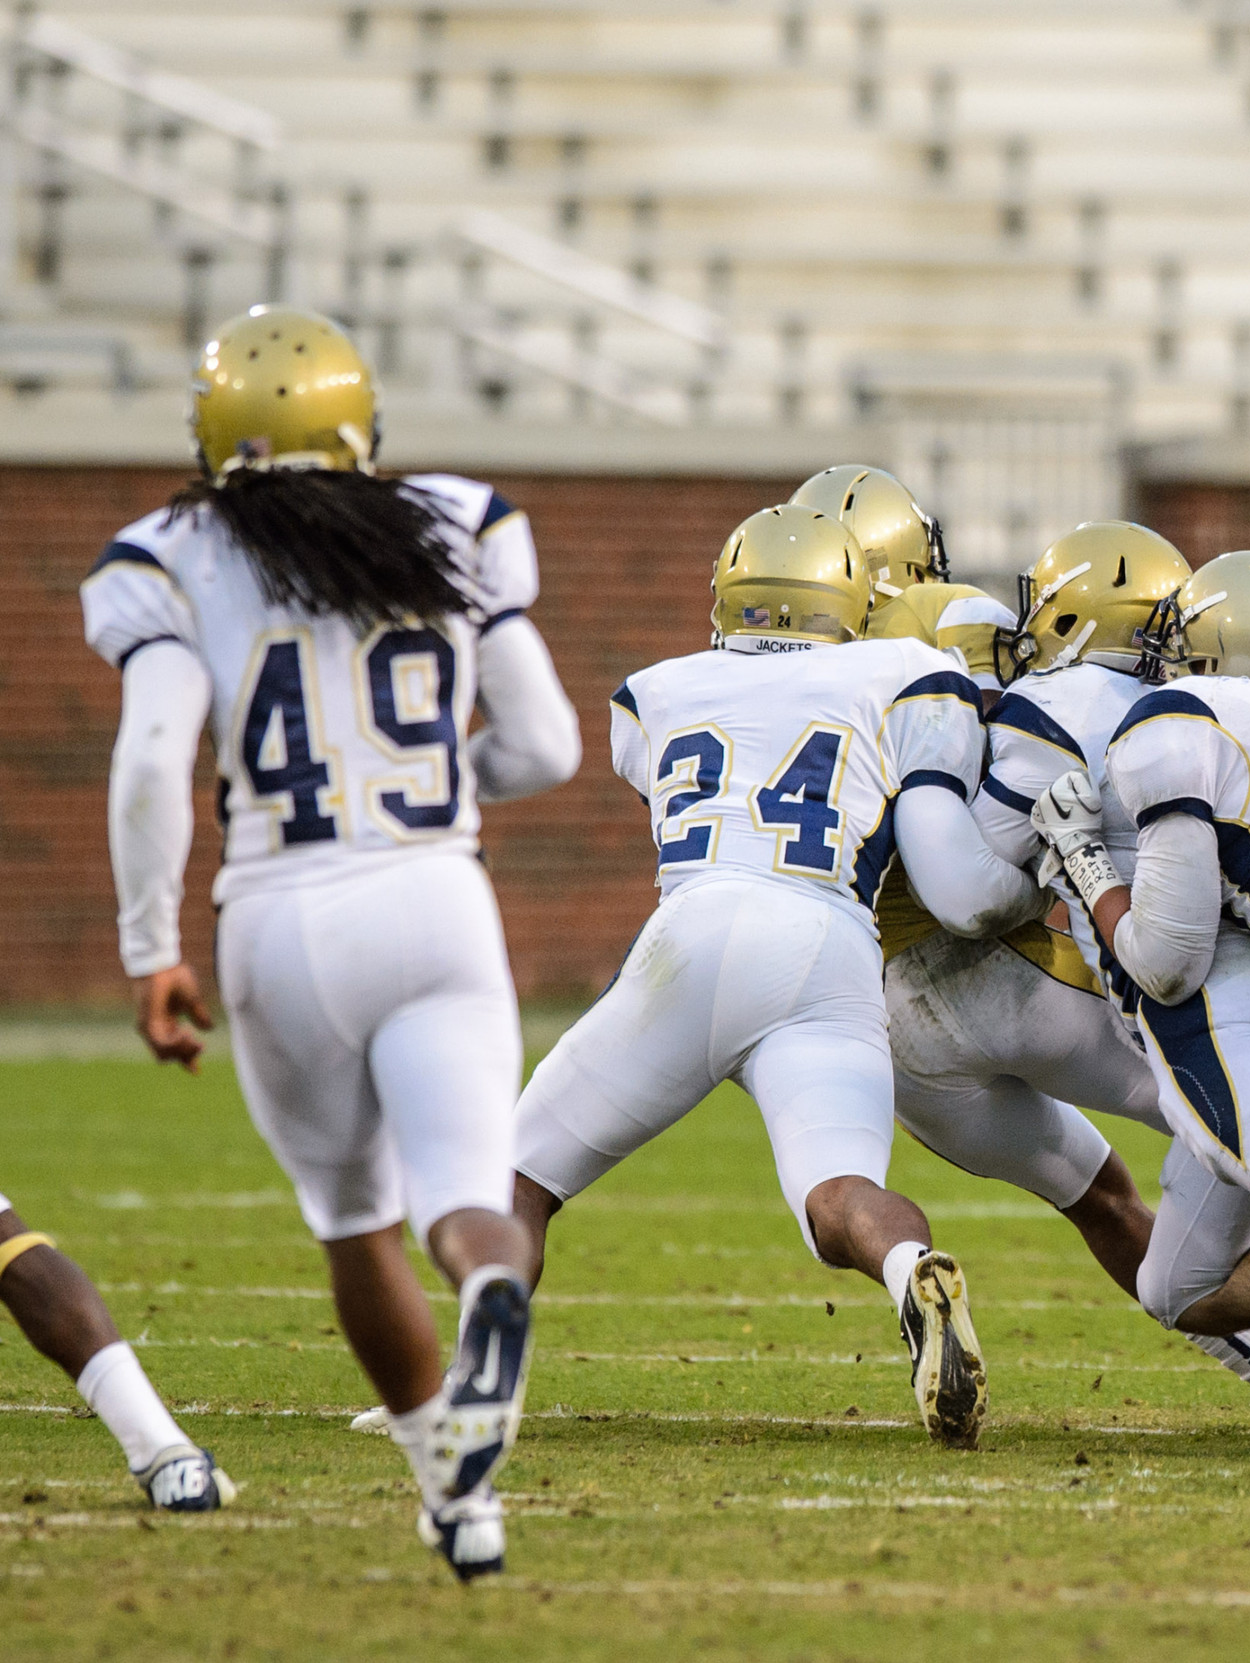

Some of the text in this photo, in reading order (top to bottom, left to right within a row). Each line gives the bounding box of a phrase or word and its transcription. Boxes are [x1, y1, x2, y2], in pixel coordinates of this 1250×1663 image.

[777, 615, 791, 628] 24
[756, 639, 812, 653] JACKETS
[235, 617, 463, 852] 49
[654, 721, 852, 883] 24
[1087, 861, 1105, 883] RIP
